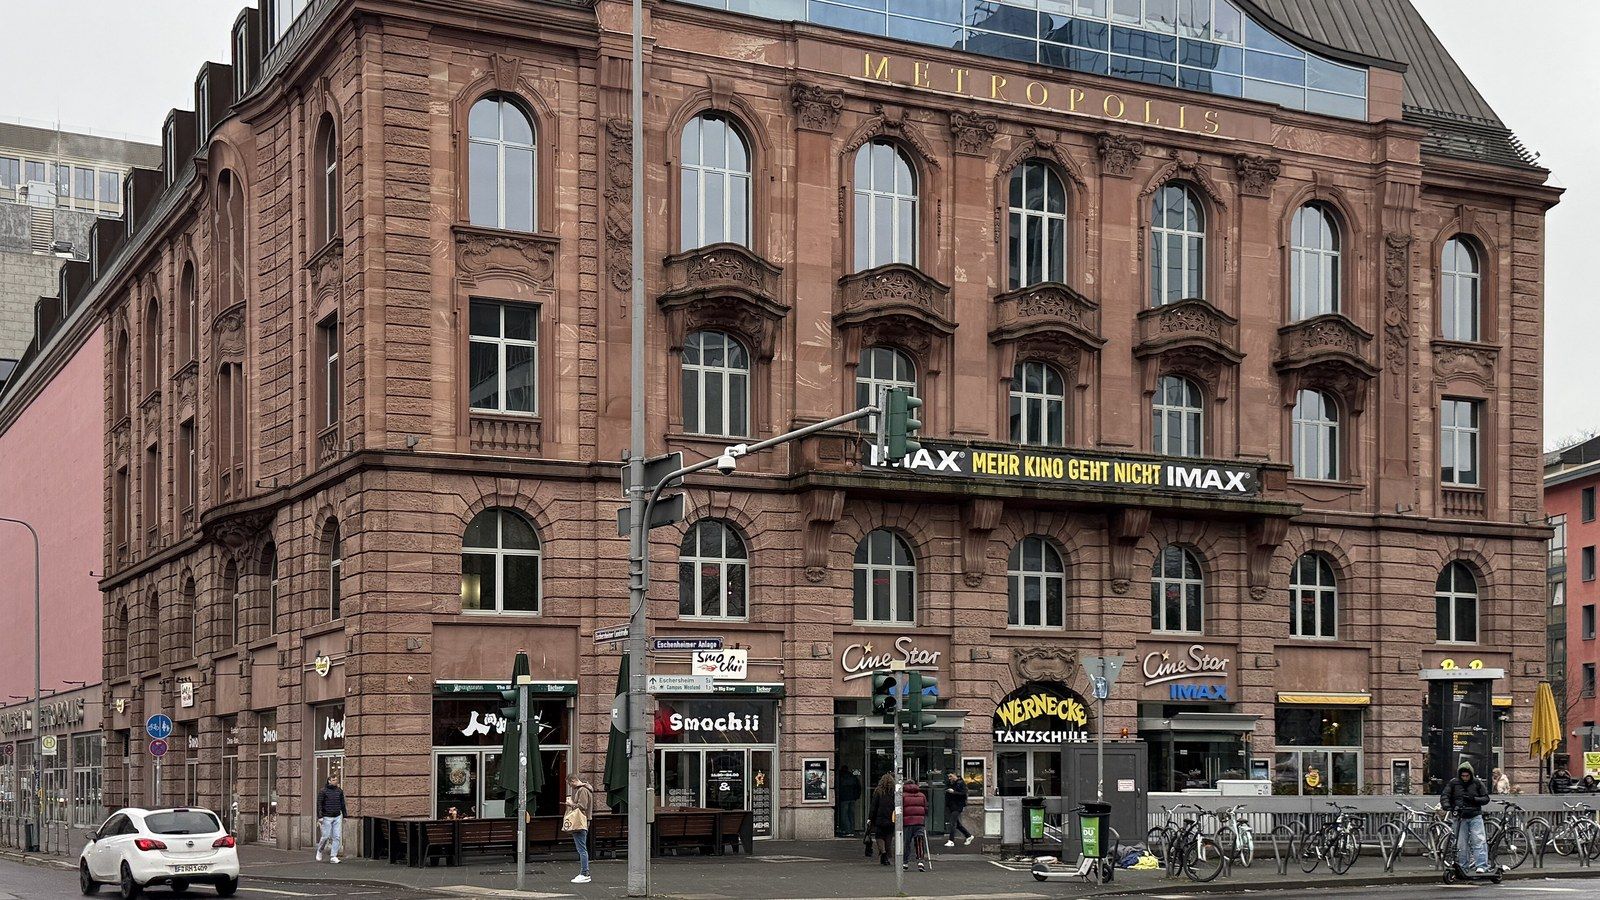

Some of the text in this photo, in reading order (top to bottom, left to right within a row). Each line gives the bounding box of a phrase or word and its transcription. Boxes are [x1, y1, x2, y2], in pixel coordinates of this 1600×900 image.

[864, 52, 1220, 135] METROPOLIS
[972, 451, 1020, 476] MEHR
[1024, 455, 1064, 479] KINO
[1068, 457, 1110, 482] GEHT
[1113, 461, 1161, 485] NICHT
[657, 640, 717, 650] Eschenheimer Anlage
[842, 636, 941, 673] CineStar
[1143, 644, 1230, 679] CineStar
[1168, 683, 1227, 701] IMAX
[996, 693, 1088, 727] WERNECKE
[995, 730, 1088, 743] TANZSCHULE
